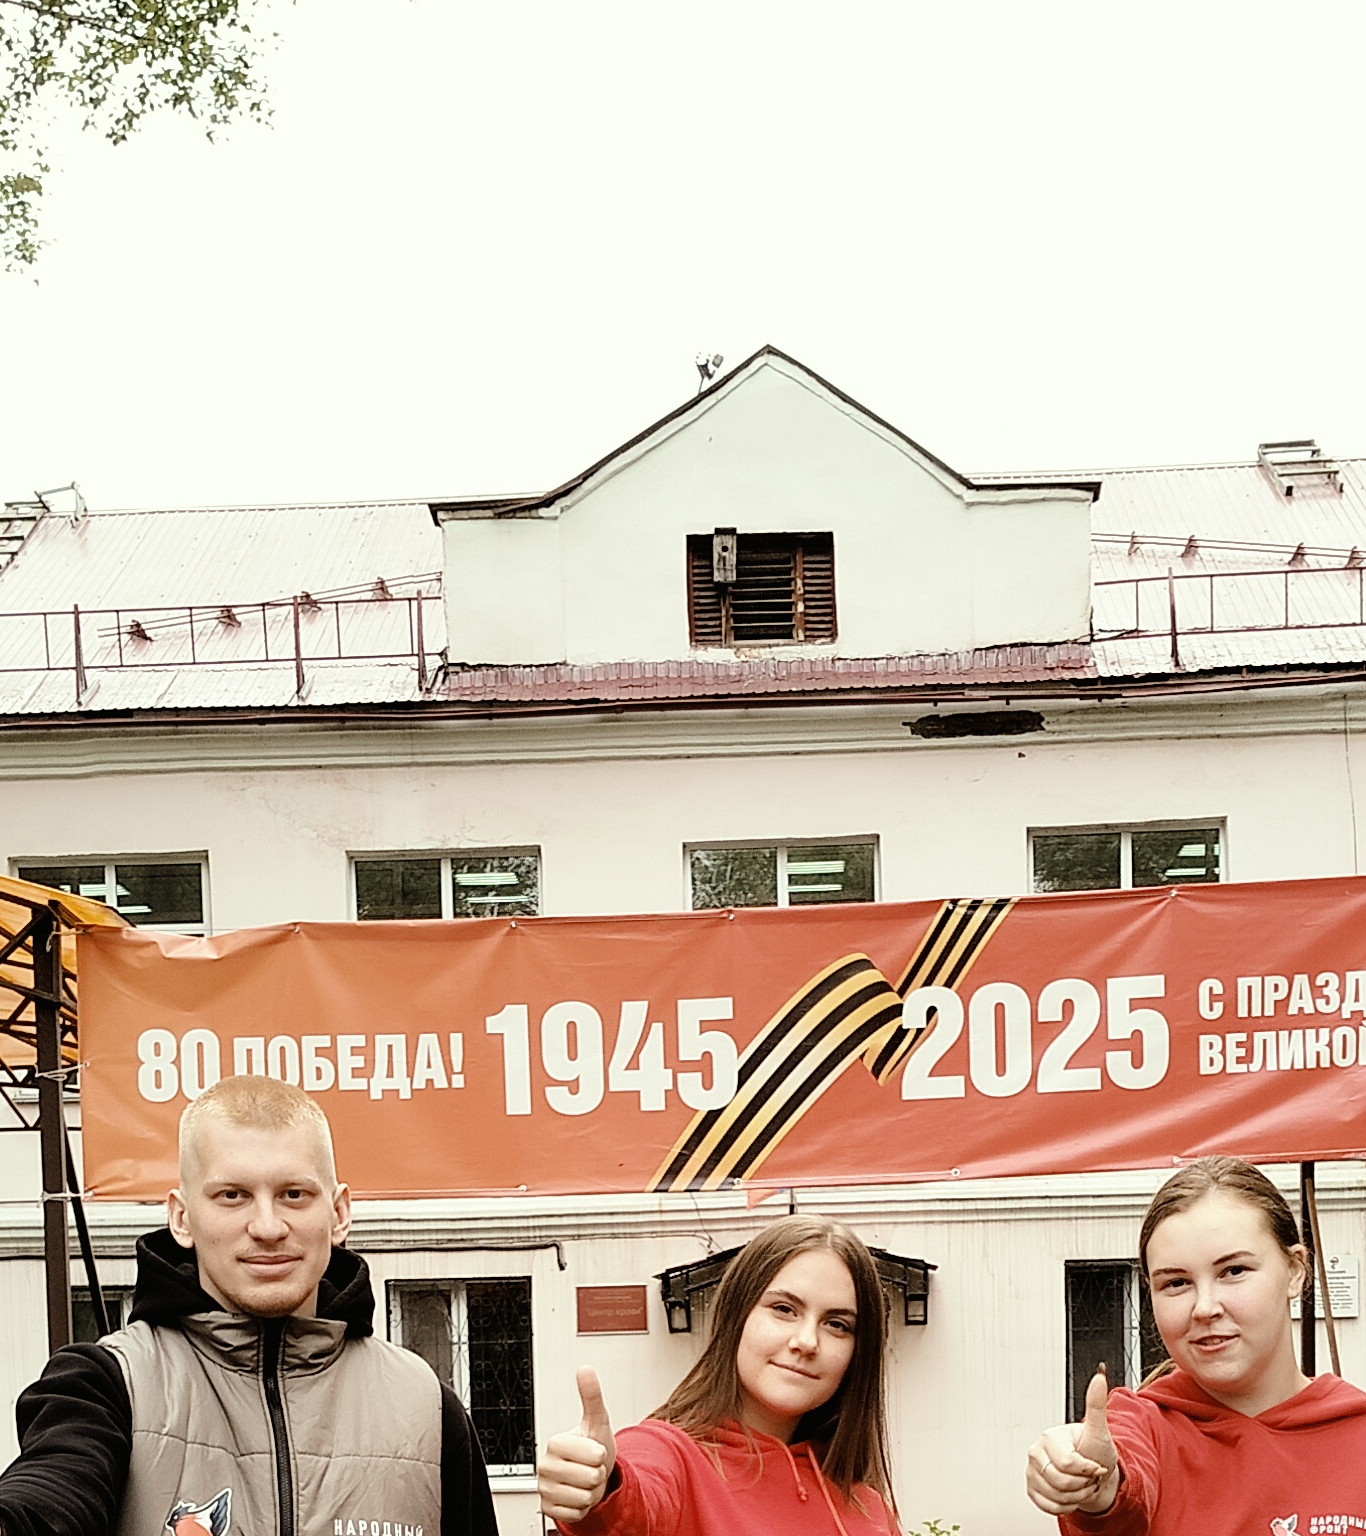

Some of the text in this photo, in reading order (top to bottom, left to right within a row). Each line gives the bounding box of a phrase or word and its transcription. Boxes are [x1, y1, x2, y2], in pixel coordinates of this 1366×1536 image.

[1198, 978, 1224, 1020] С
[137, 1028, 466, 1103] 80 ПОБЕДА!
[485, 975, 1170, 1117] 1945 2025
[1309, 1525, 1348, 1535] ФРОНТ
